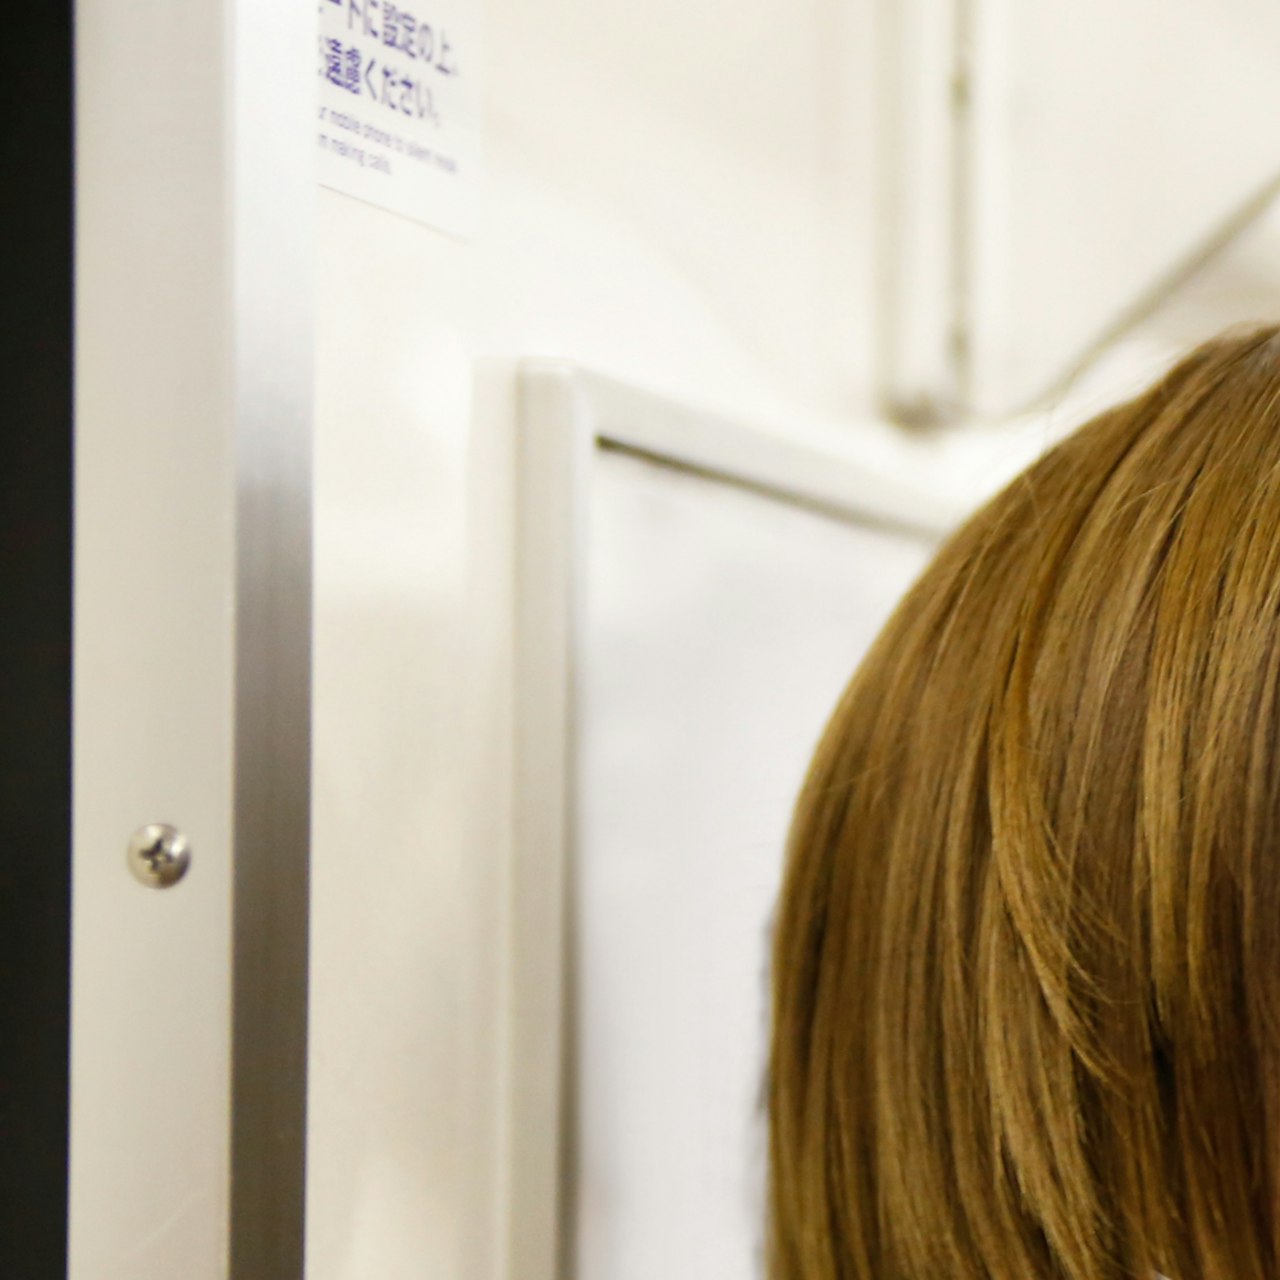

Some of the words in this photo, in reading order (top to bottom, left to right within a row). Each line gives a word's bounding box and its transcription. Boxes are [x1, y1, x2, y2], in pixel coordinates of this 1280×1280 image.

[318, 36, 441, 128] 遠慮ください。
